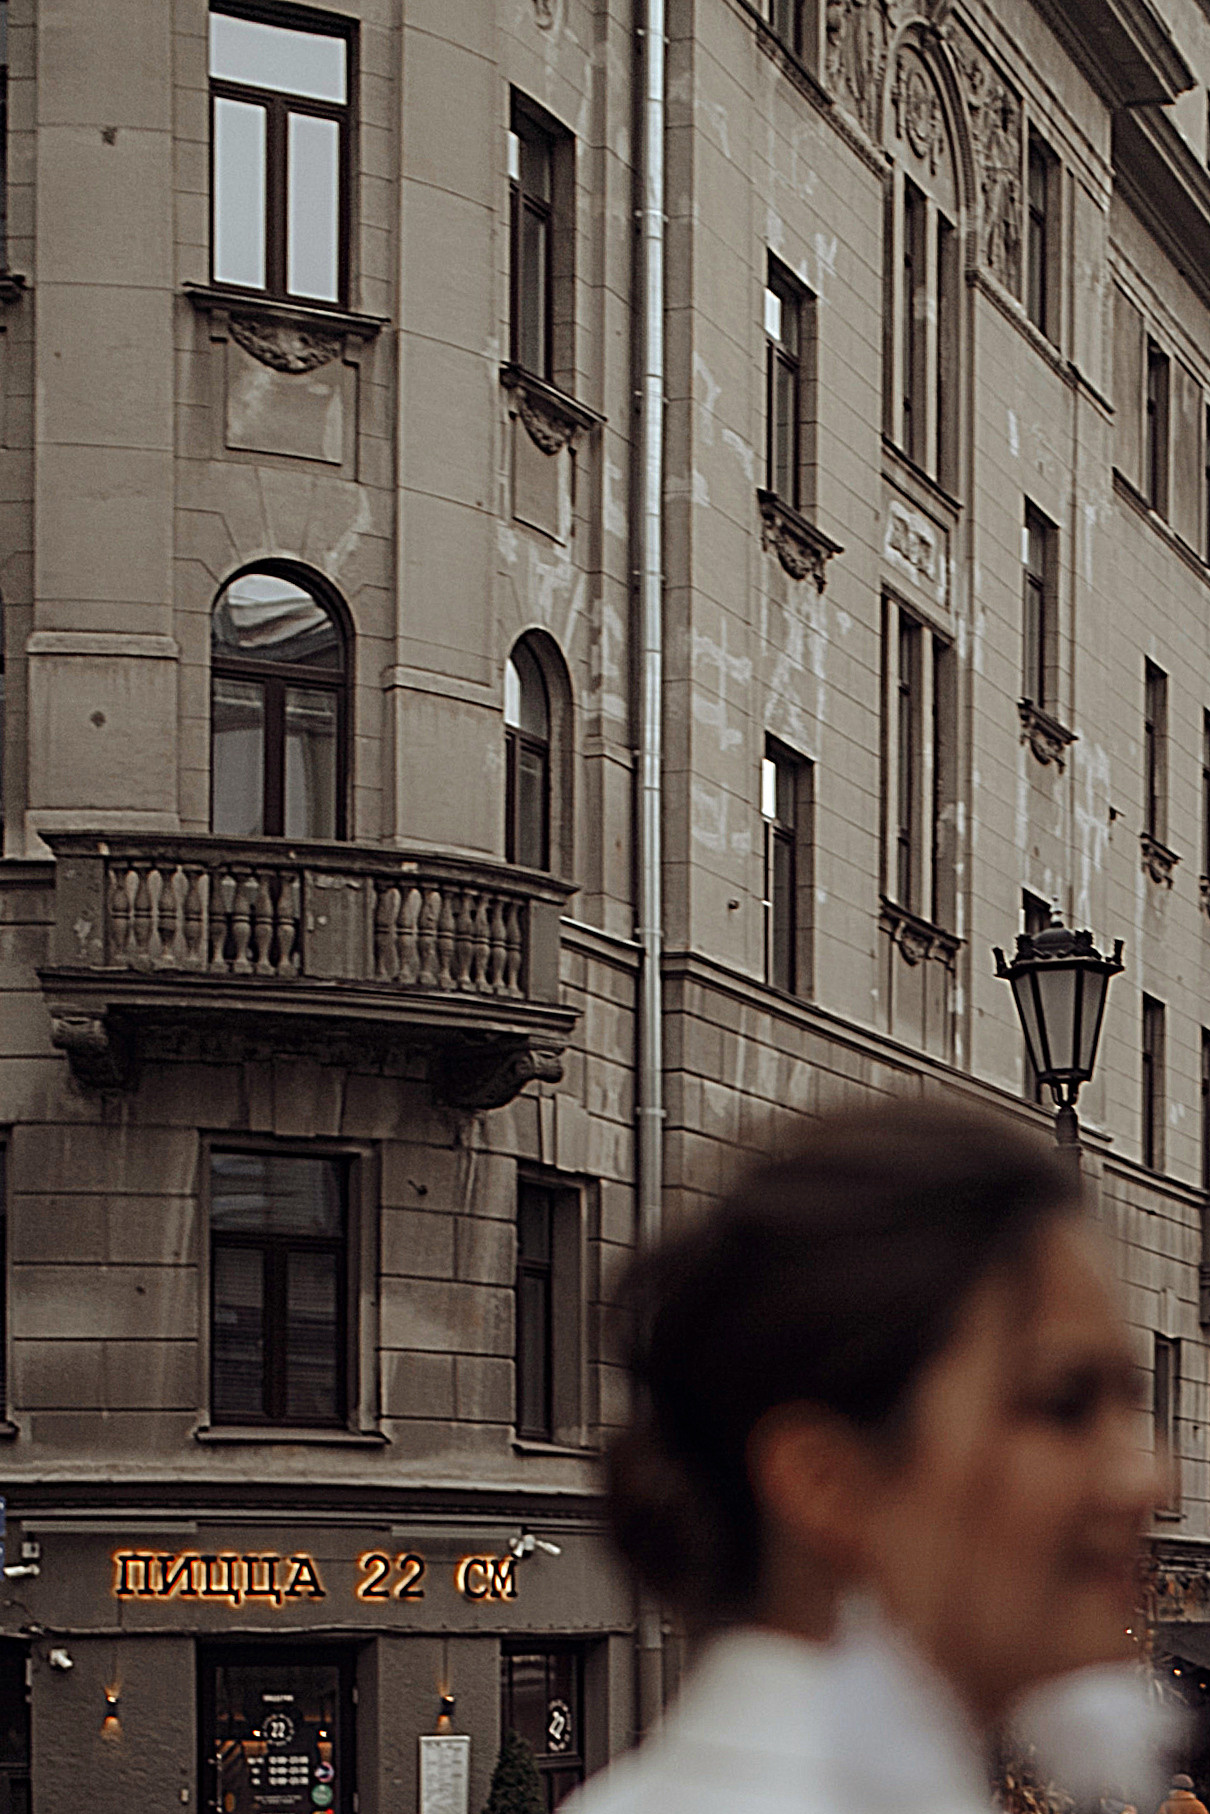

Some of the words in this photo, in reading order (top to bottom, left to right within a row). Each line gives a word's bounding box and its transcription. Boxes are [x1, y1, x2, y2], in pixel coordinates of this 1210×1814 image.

[114, 1552, 327, 1606] ПИЦЦА
[360, 1552, 425, 1599] 22
[461, 1556, 518, 1599] СМ
